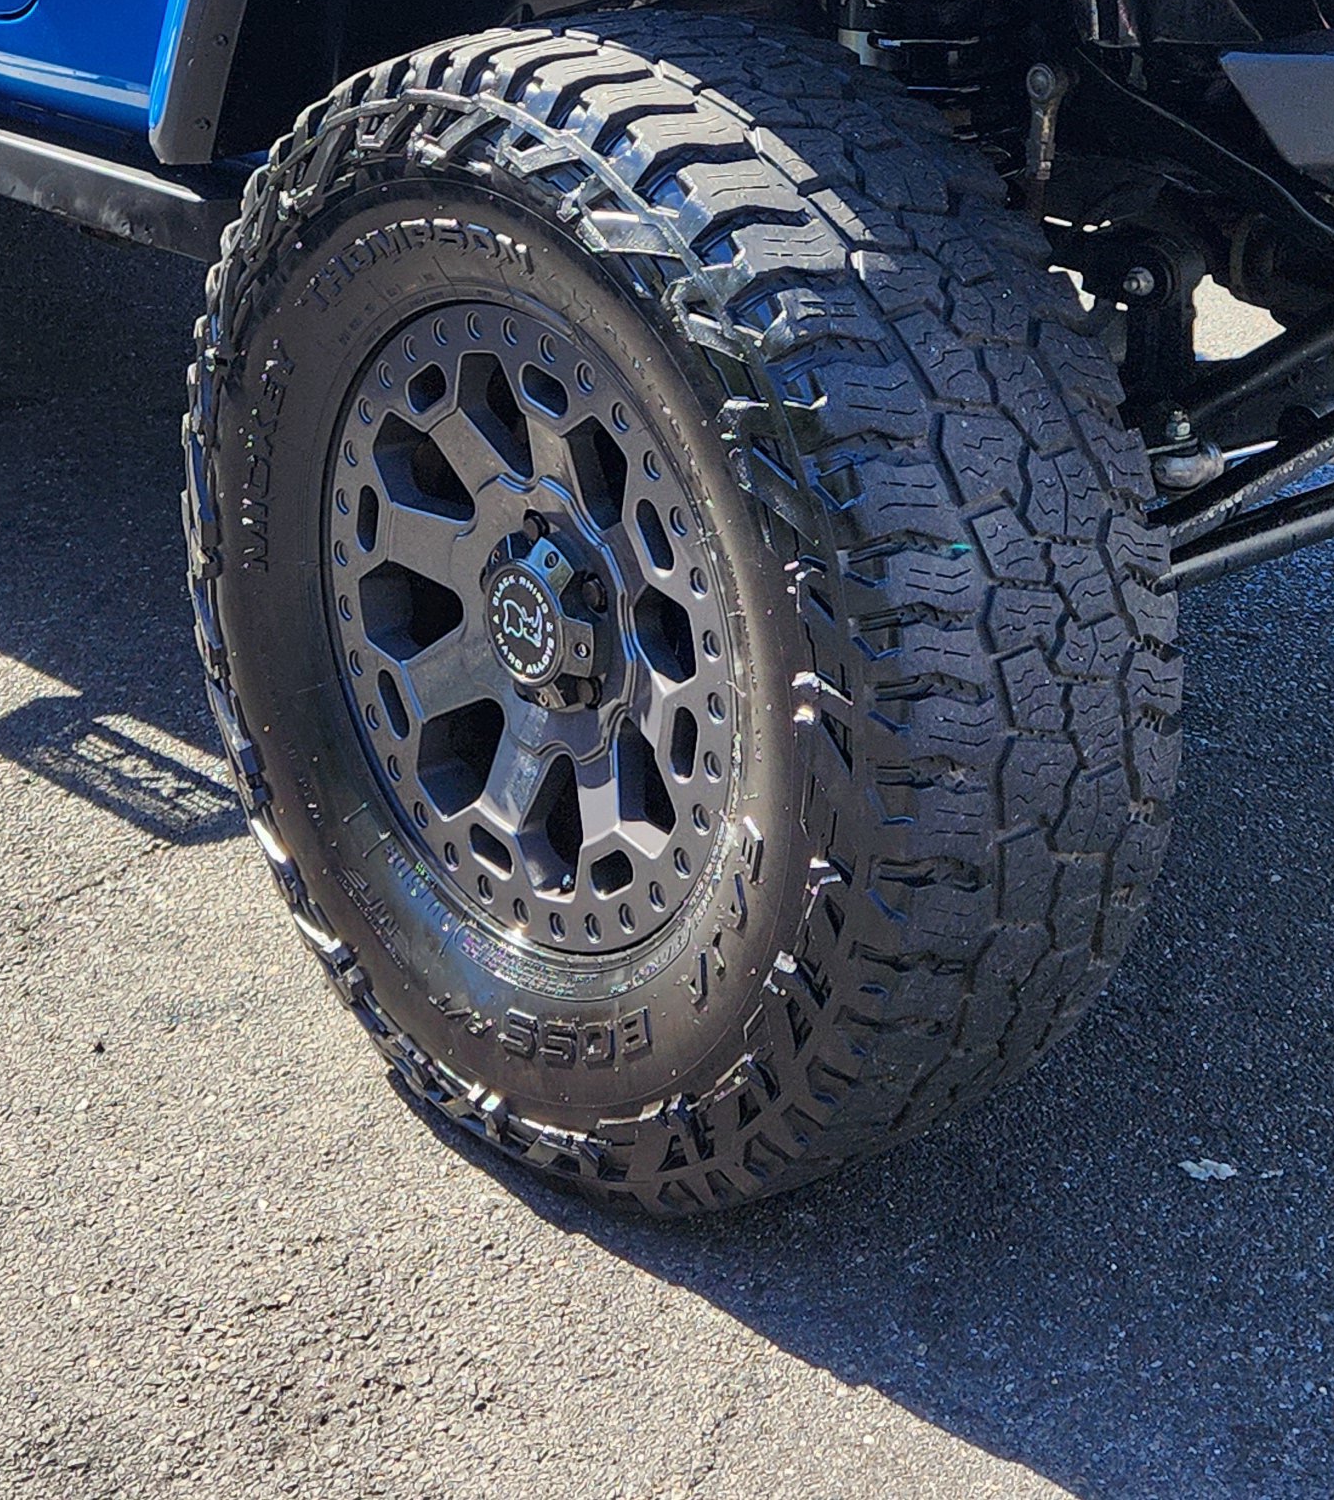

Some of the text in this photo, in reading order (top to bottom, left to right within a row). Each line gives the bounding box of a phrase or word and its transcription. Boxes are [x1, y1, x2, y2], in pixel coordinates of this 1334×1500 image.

[294, 217, 536, 314] THOMPSON
[492, 574, 549, 614] BLACK RHINO
[495, 631, 555, 674] HARD ALLOYS
[497, 1006, 653, 1069] BOSS
